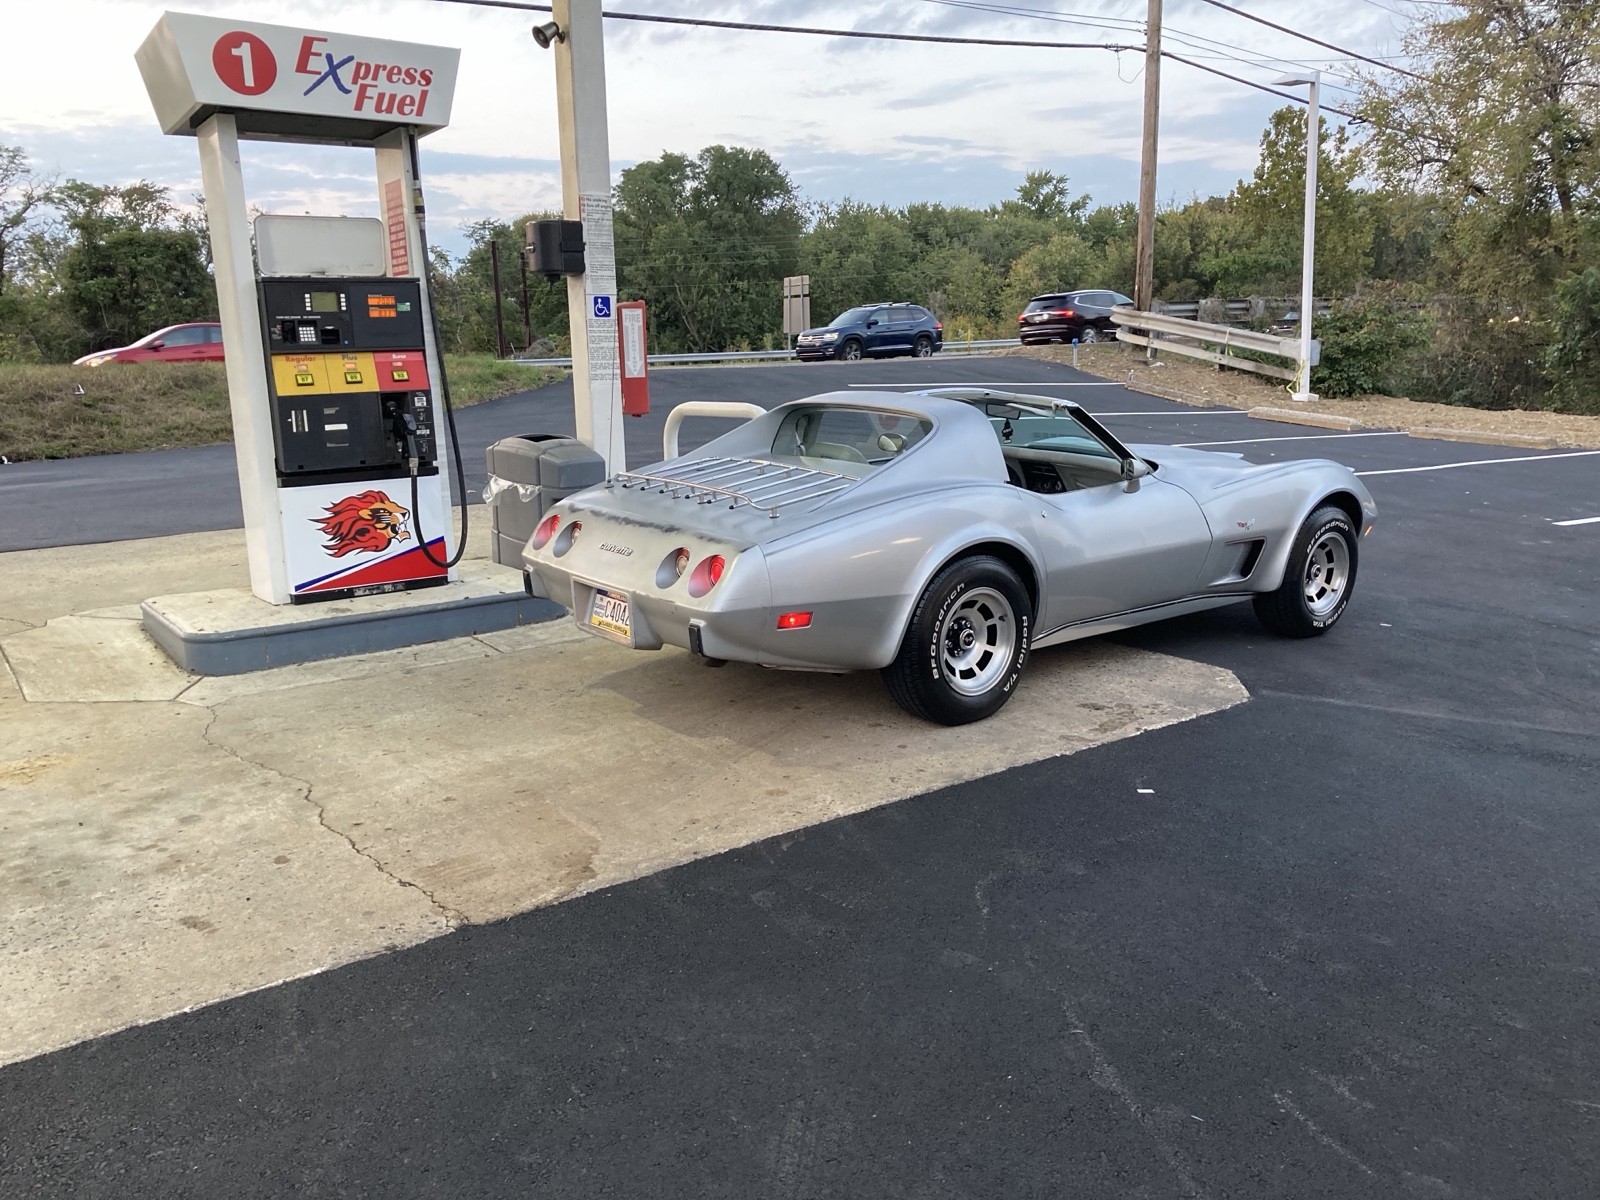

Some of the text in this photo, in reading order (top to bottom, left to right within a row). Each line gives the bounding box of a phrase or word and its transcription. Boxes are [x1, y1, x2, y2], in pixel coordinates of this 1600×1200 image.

[231, 41, 255, 87] 1
[354, 83, 429, 117] Fuel
[624, 313, 641, 323] FIRE
[285, 355, 316, 363] Regular
[342, 353, 358, 361] Plus
[930, 582, 965, 679] BFGoodrich
[1003, 616, 1029, 692] Radial T/A
